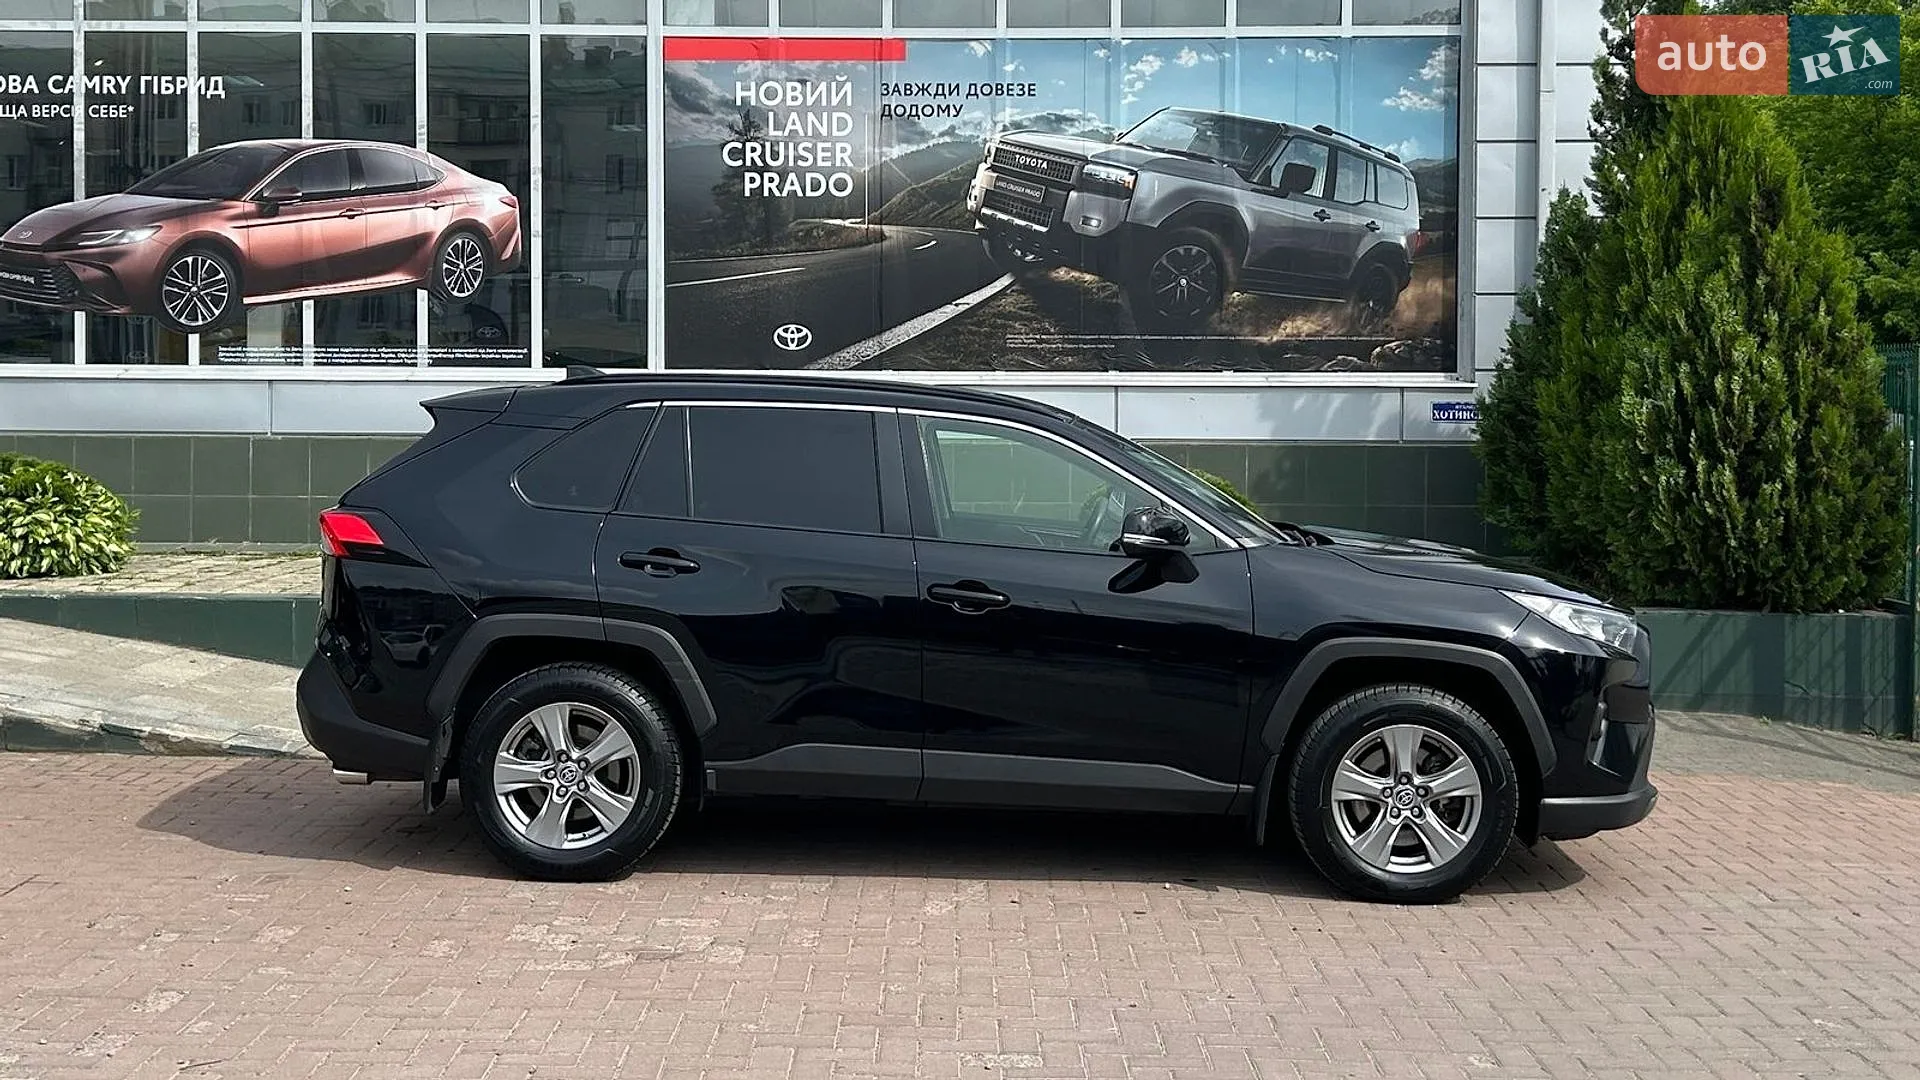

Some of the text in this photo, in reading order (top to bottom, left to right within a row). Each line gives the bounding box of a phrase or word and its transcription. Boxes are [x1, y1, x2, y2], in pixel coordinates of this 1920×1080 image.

[47, 75, 132, 95] CAMRY
[736, 74, 852, 106] НОВИЙ
[881, 83, 1037, 99] ЗАВЖДИ ДОВЕЗЕ
[32, 104, 83, 118] ВЕРСІ
[881, 104, 963, 120] ДОДОМУ
[768, 112, 854, 137] LAND
[722, 142, 855, 167] CRUISER
[1015, 154, 1048, 169] TOYOTA
[744, 172, 854, 198] PRADO
